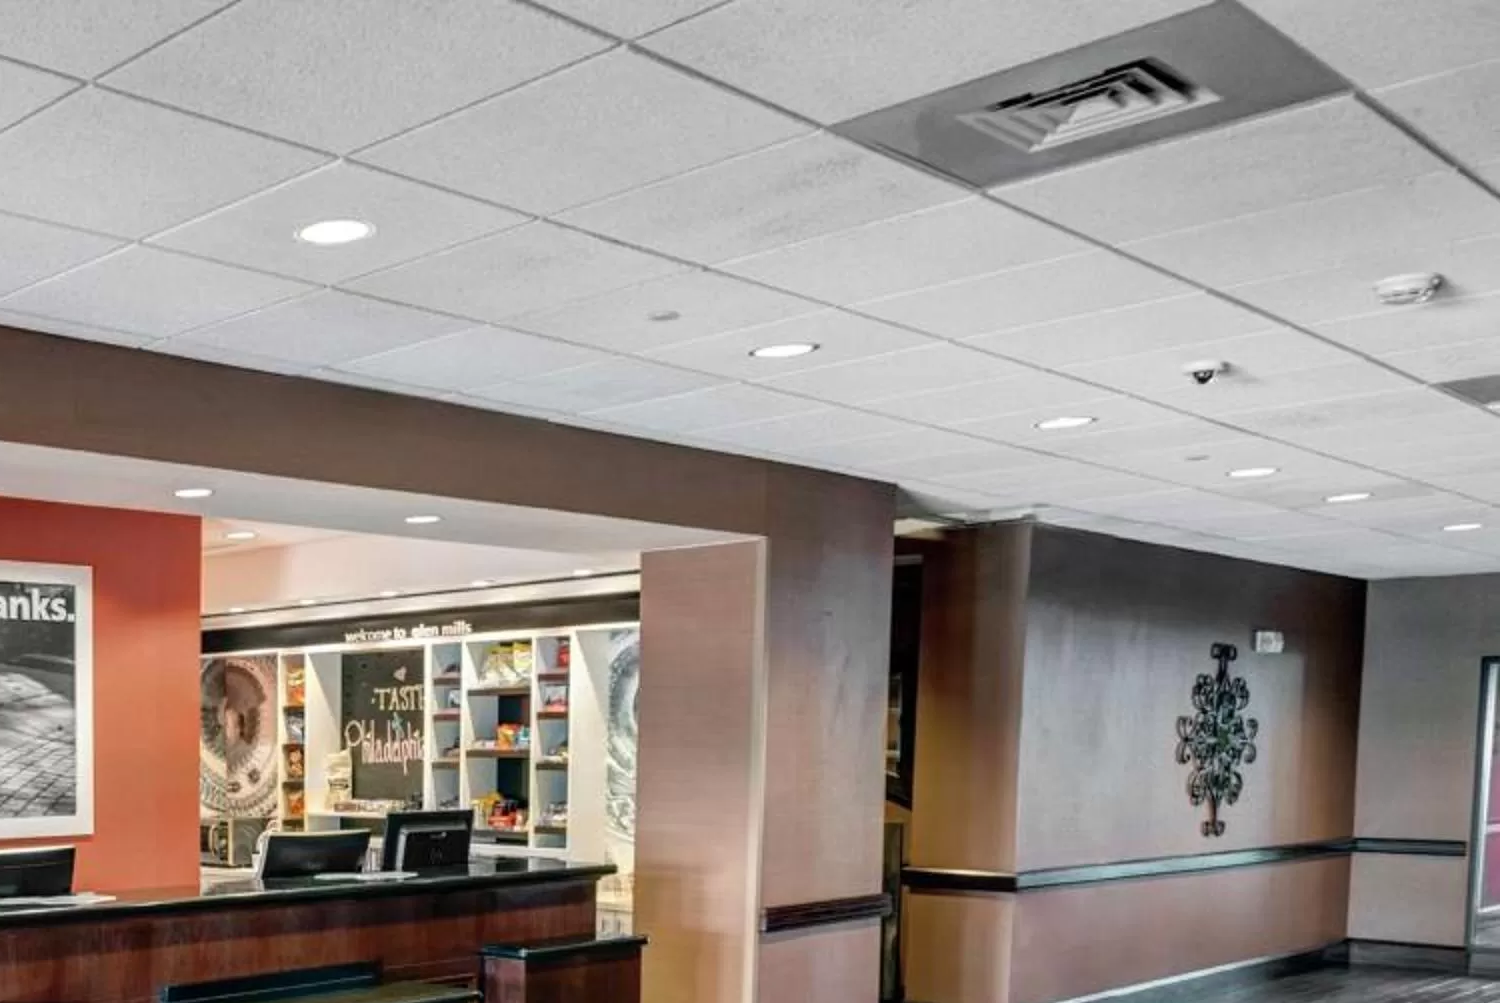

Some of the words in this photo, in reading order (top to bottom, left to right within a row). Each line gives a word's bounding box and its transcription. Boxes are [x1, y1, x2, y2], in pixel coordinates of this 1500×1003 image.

[345, 629, 392, 643] welcome
[393, 627, 406, 640] to
[411, 623, 438, 638] glen
[441, 620, 472, 636] mills
